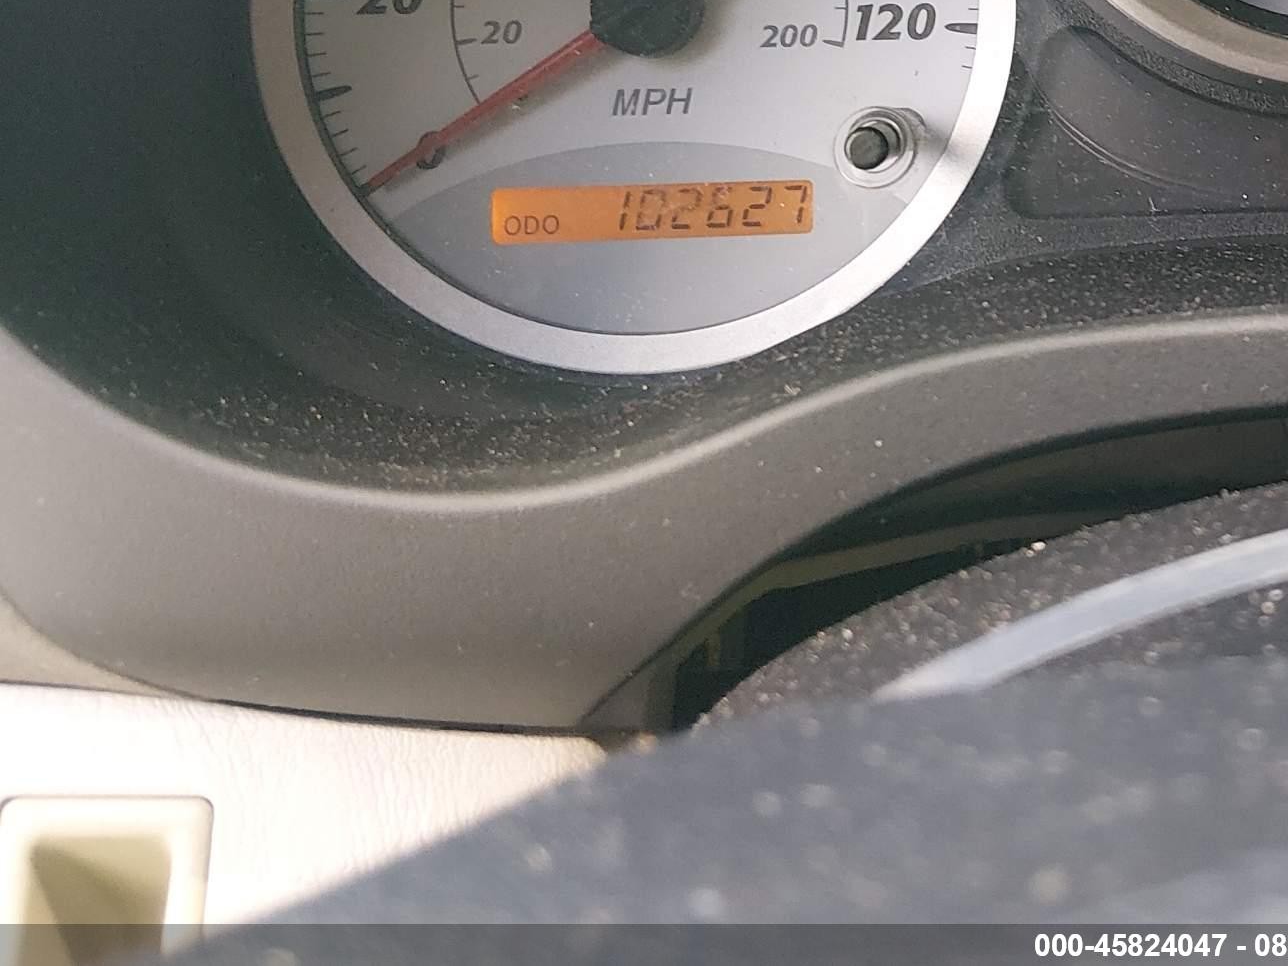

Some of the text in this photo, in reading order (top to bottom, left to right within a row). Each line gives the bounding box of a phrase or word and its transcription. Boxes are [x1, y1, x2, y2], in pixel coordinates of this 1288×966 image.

[482, 19, 521, 43] 20
[854, 2, 936, 40] 120
[761, 24, 818, 47] 200
[612, 88, 692, 116] MPH
[505, 215, 559, 236] ODO
